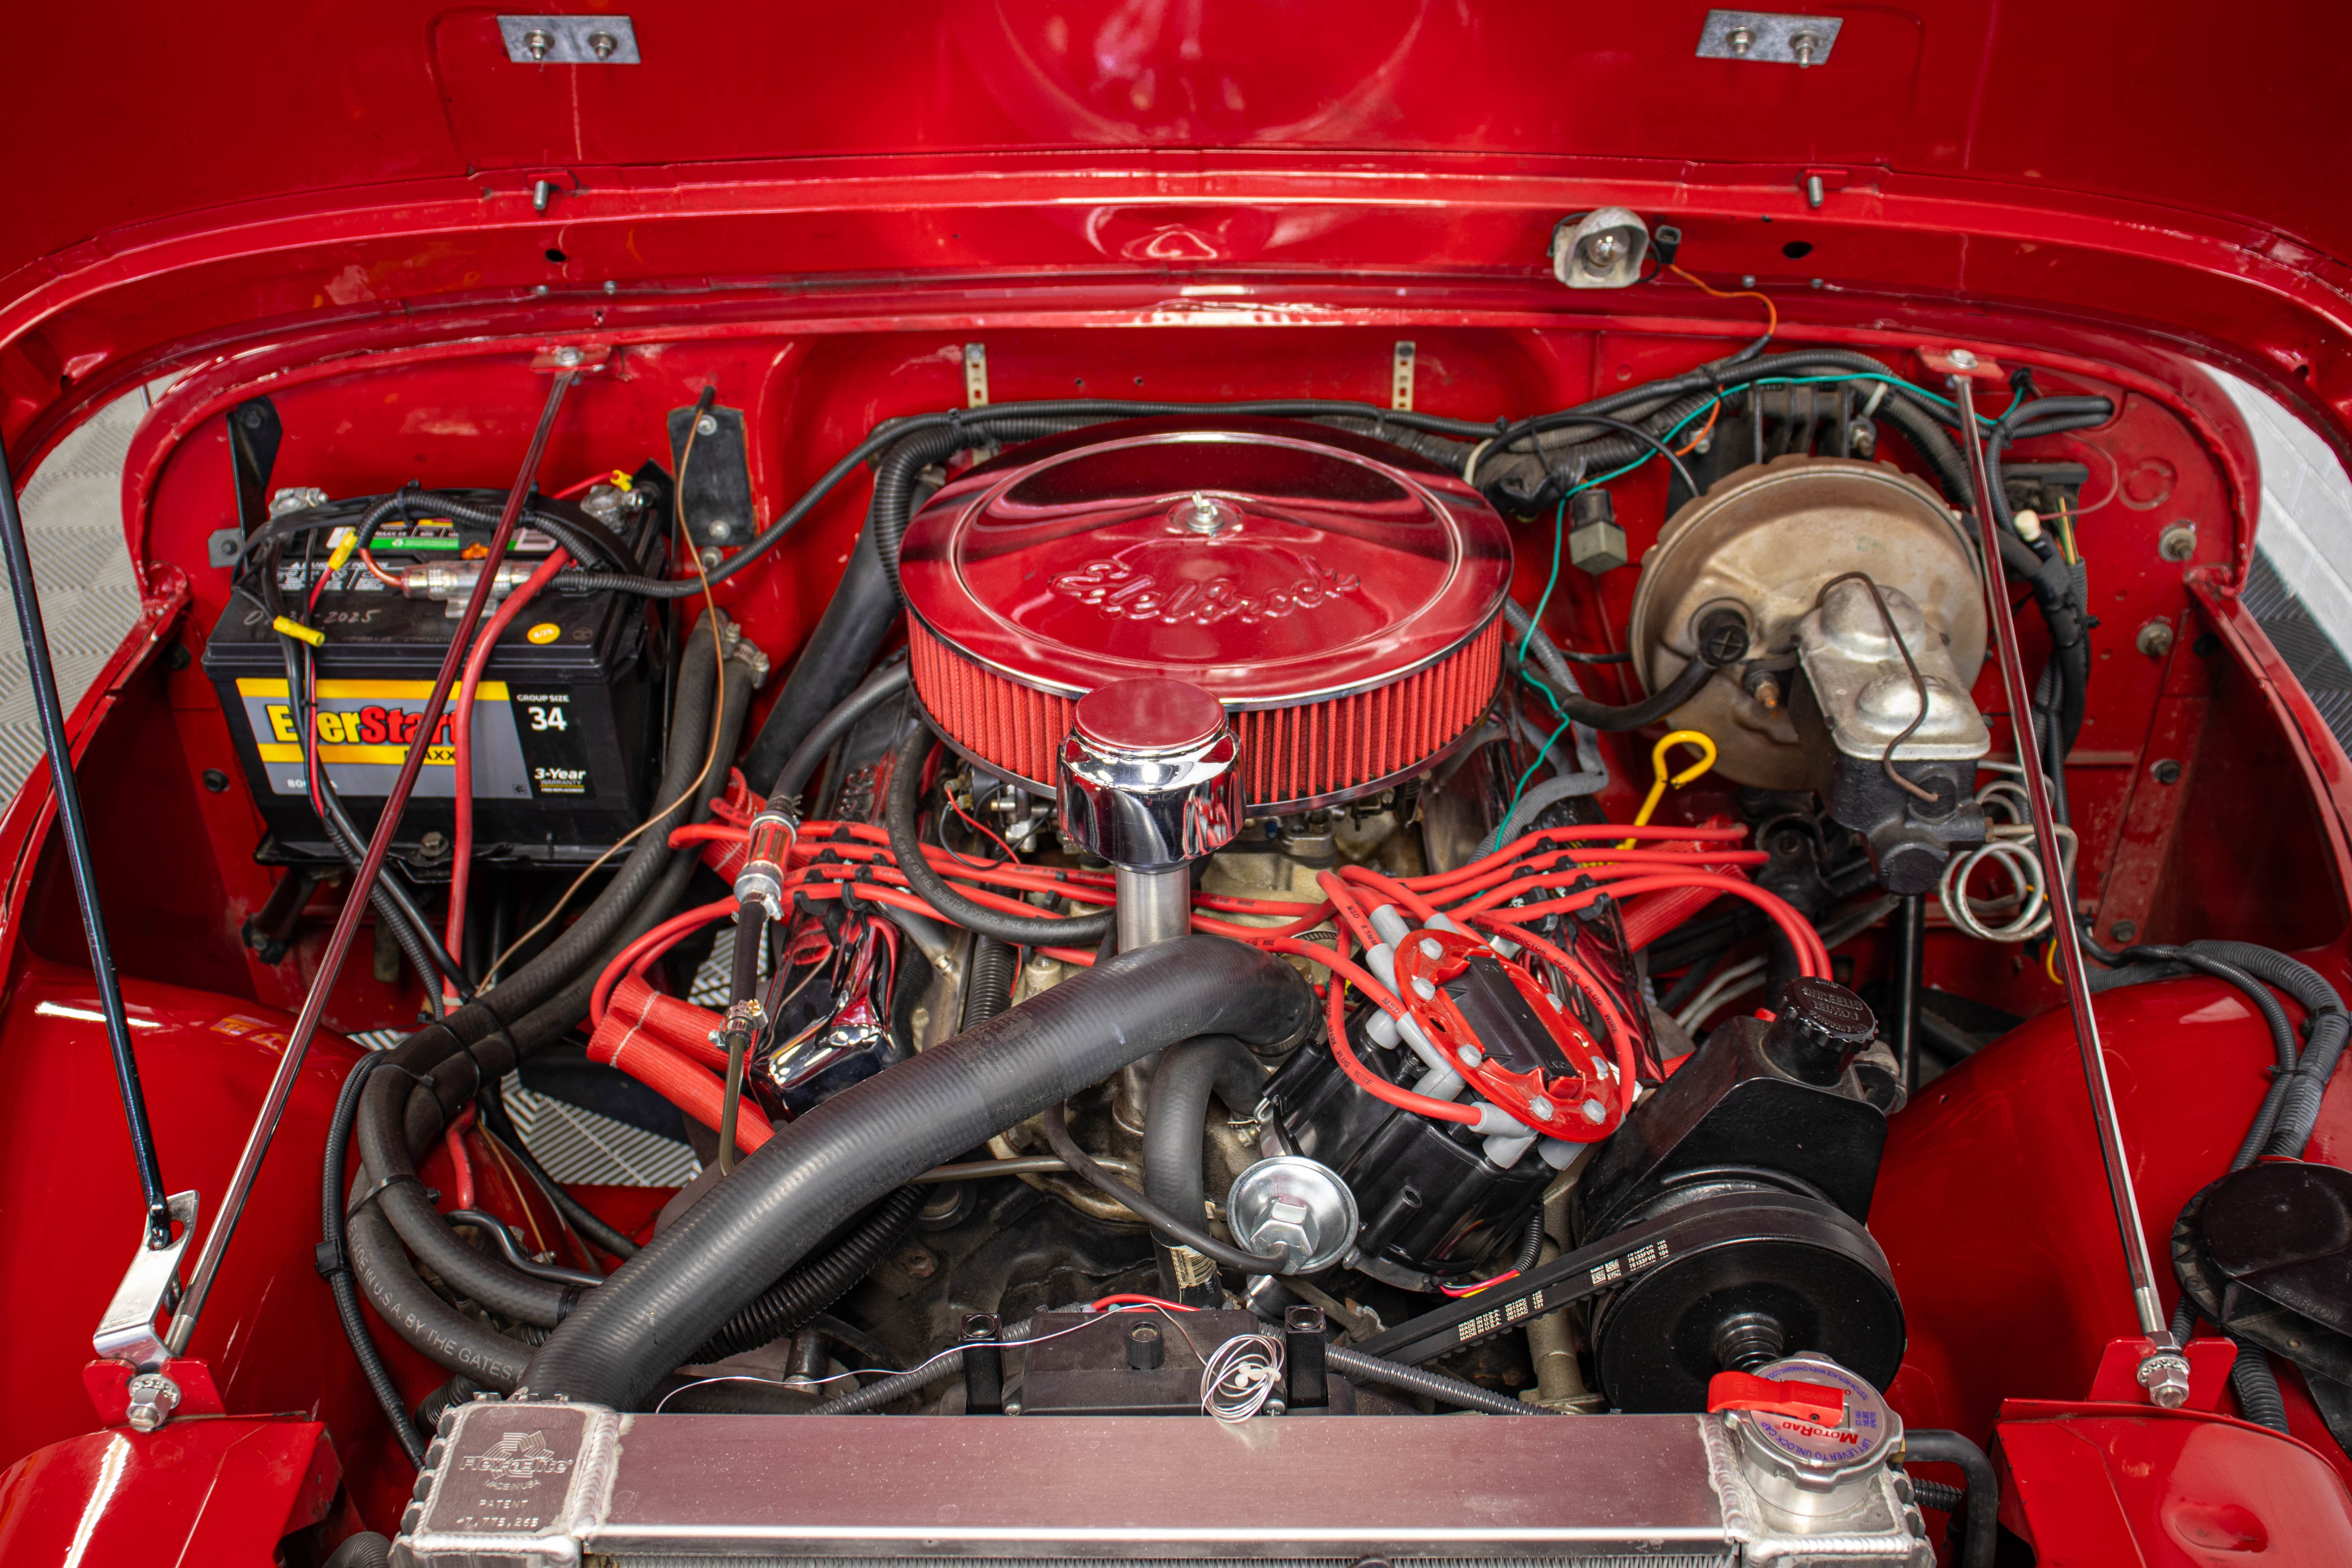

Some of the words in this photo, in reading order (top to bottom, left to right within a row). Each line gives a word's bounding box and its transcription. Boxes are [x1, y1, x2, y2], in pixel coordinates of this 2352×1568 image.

[516, 694, 548, 702] GROUP
[549, 695, 570, 703] SIZE
[528, 706, 568, 731] 34
[534, 767, 587, 780] 3-Year
[968, 908, 1000, 924] SYSTEMS
[1003, 919, 1023, 929] MADE
[1346, 905, 1360, 919] MSD
[1499, 929, 1548, 955] CONDUCTOR
[1554, 956, 1581, 980] SPARK
[1584, 984, 1604, 1007] PLUG
[1604, 1013, 1619, 1035] WIRE
[1382, 997, 1401, 1015] MSD
[1802, 987, 1863, 1011] STEERING
[1812, 1000, 1858, 1021] POWER
[1328, 1025, 1337, 1047] SPARK
[1336, 1050, 1350, 1069] PLUG
[1353, 1070, 1373, 1086] WIRE
[1628, 1248, 1655, 1264] 76133FVR
[1629, 1254, 1656, 1269] 76133FVR
[1659, 1249, 1669, 1257] 104
[350, 1236, 368, 1272] MADE
[363, 1268, 377, 1286] IN
[405, 1312, 426, 1334] BY
[427, 1329, 457, 1356] THE
[459, 1347, 513, 1381] GATES
[2272, 1285, 2341, 1323] SPARTON
[1458, 1322, 1476, 1333] MADE
[1483, 1313, 1501, 1322] U.S.A.
[1505, 1300, 1527, 1313] 0613AC
[1459, 1327, 1476, 1337] MADE
[1484, 1317, 1501, 1327] U.S.A.
[1506, 1304, 1528, 1317] 0613AC
[1460, 1332, 1477, 1342] MADE
[1485, 1321, 1502, 1331] U.S.A.
[1507, 1309, 1529, 1321] 0613AC
[1761, 1421, 1777, 1436] CAP
[1776, 1435, 1812, 1457] UNLOCK
[1831, 1448, 1859, 1460] LEVER
[1858, 1438, 1873, 1450] LIFT
[1815, 1452, 1828, 1461] TO
[520, 1479, 542, 1490] USA
[479, 1499, 529, 1509] PATENT
